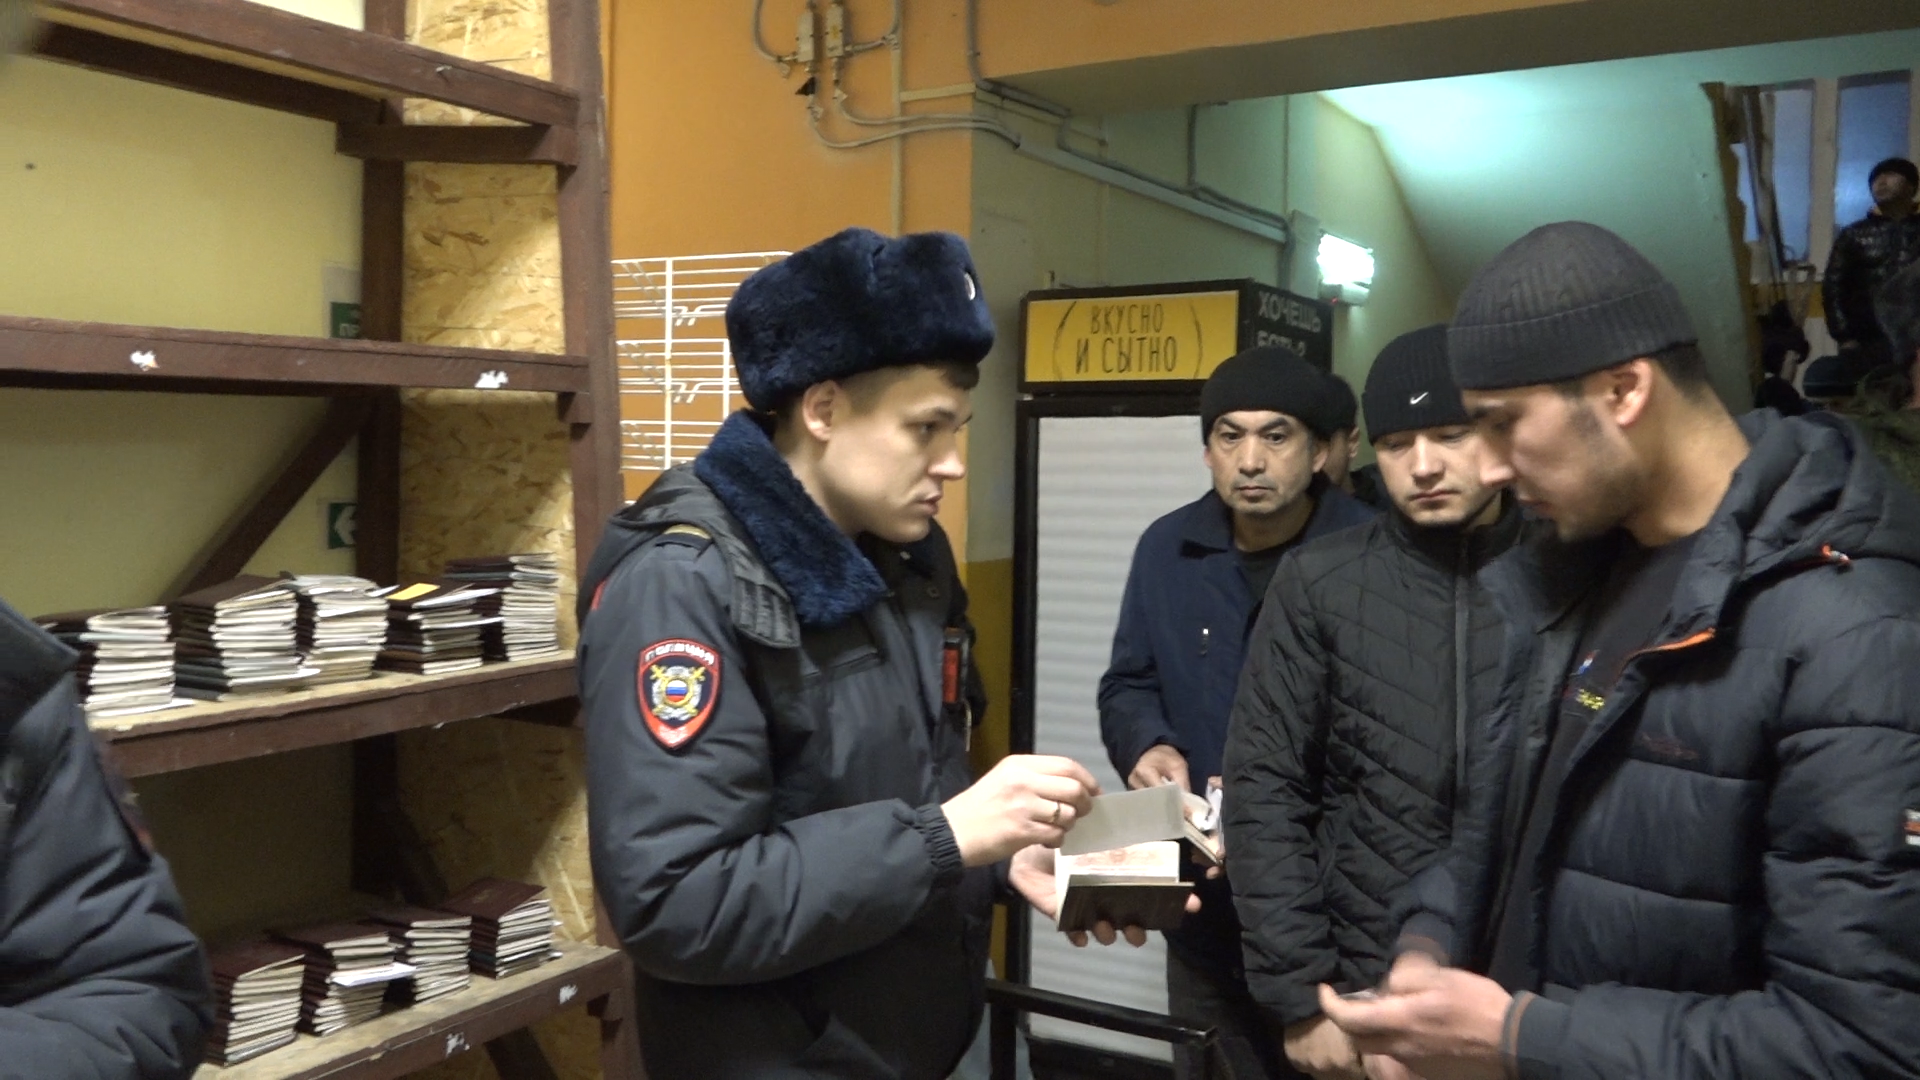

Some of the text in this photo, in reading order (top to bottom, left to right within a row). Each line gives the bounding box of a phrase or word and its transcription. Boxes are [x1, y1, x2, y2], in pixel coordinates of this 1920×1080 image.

[1091, 303, 1163, 334] ВКУСНО
[1258, 290, 1321, 333] ХОЧЕШЬ
[1076, 336, 1177, 374] И СЫТНО
